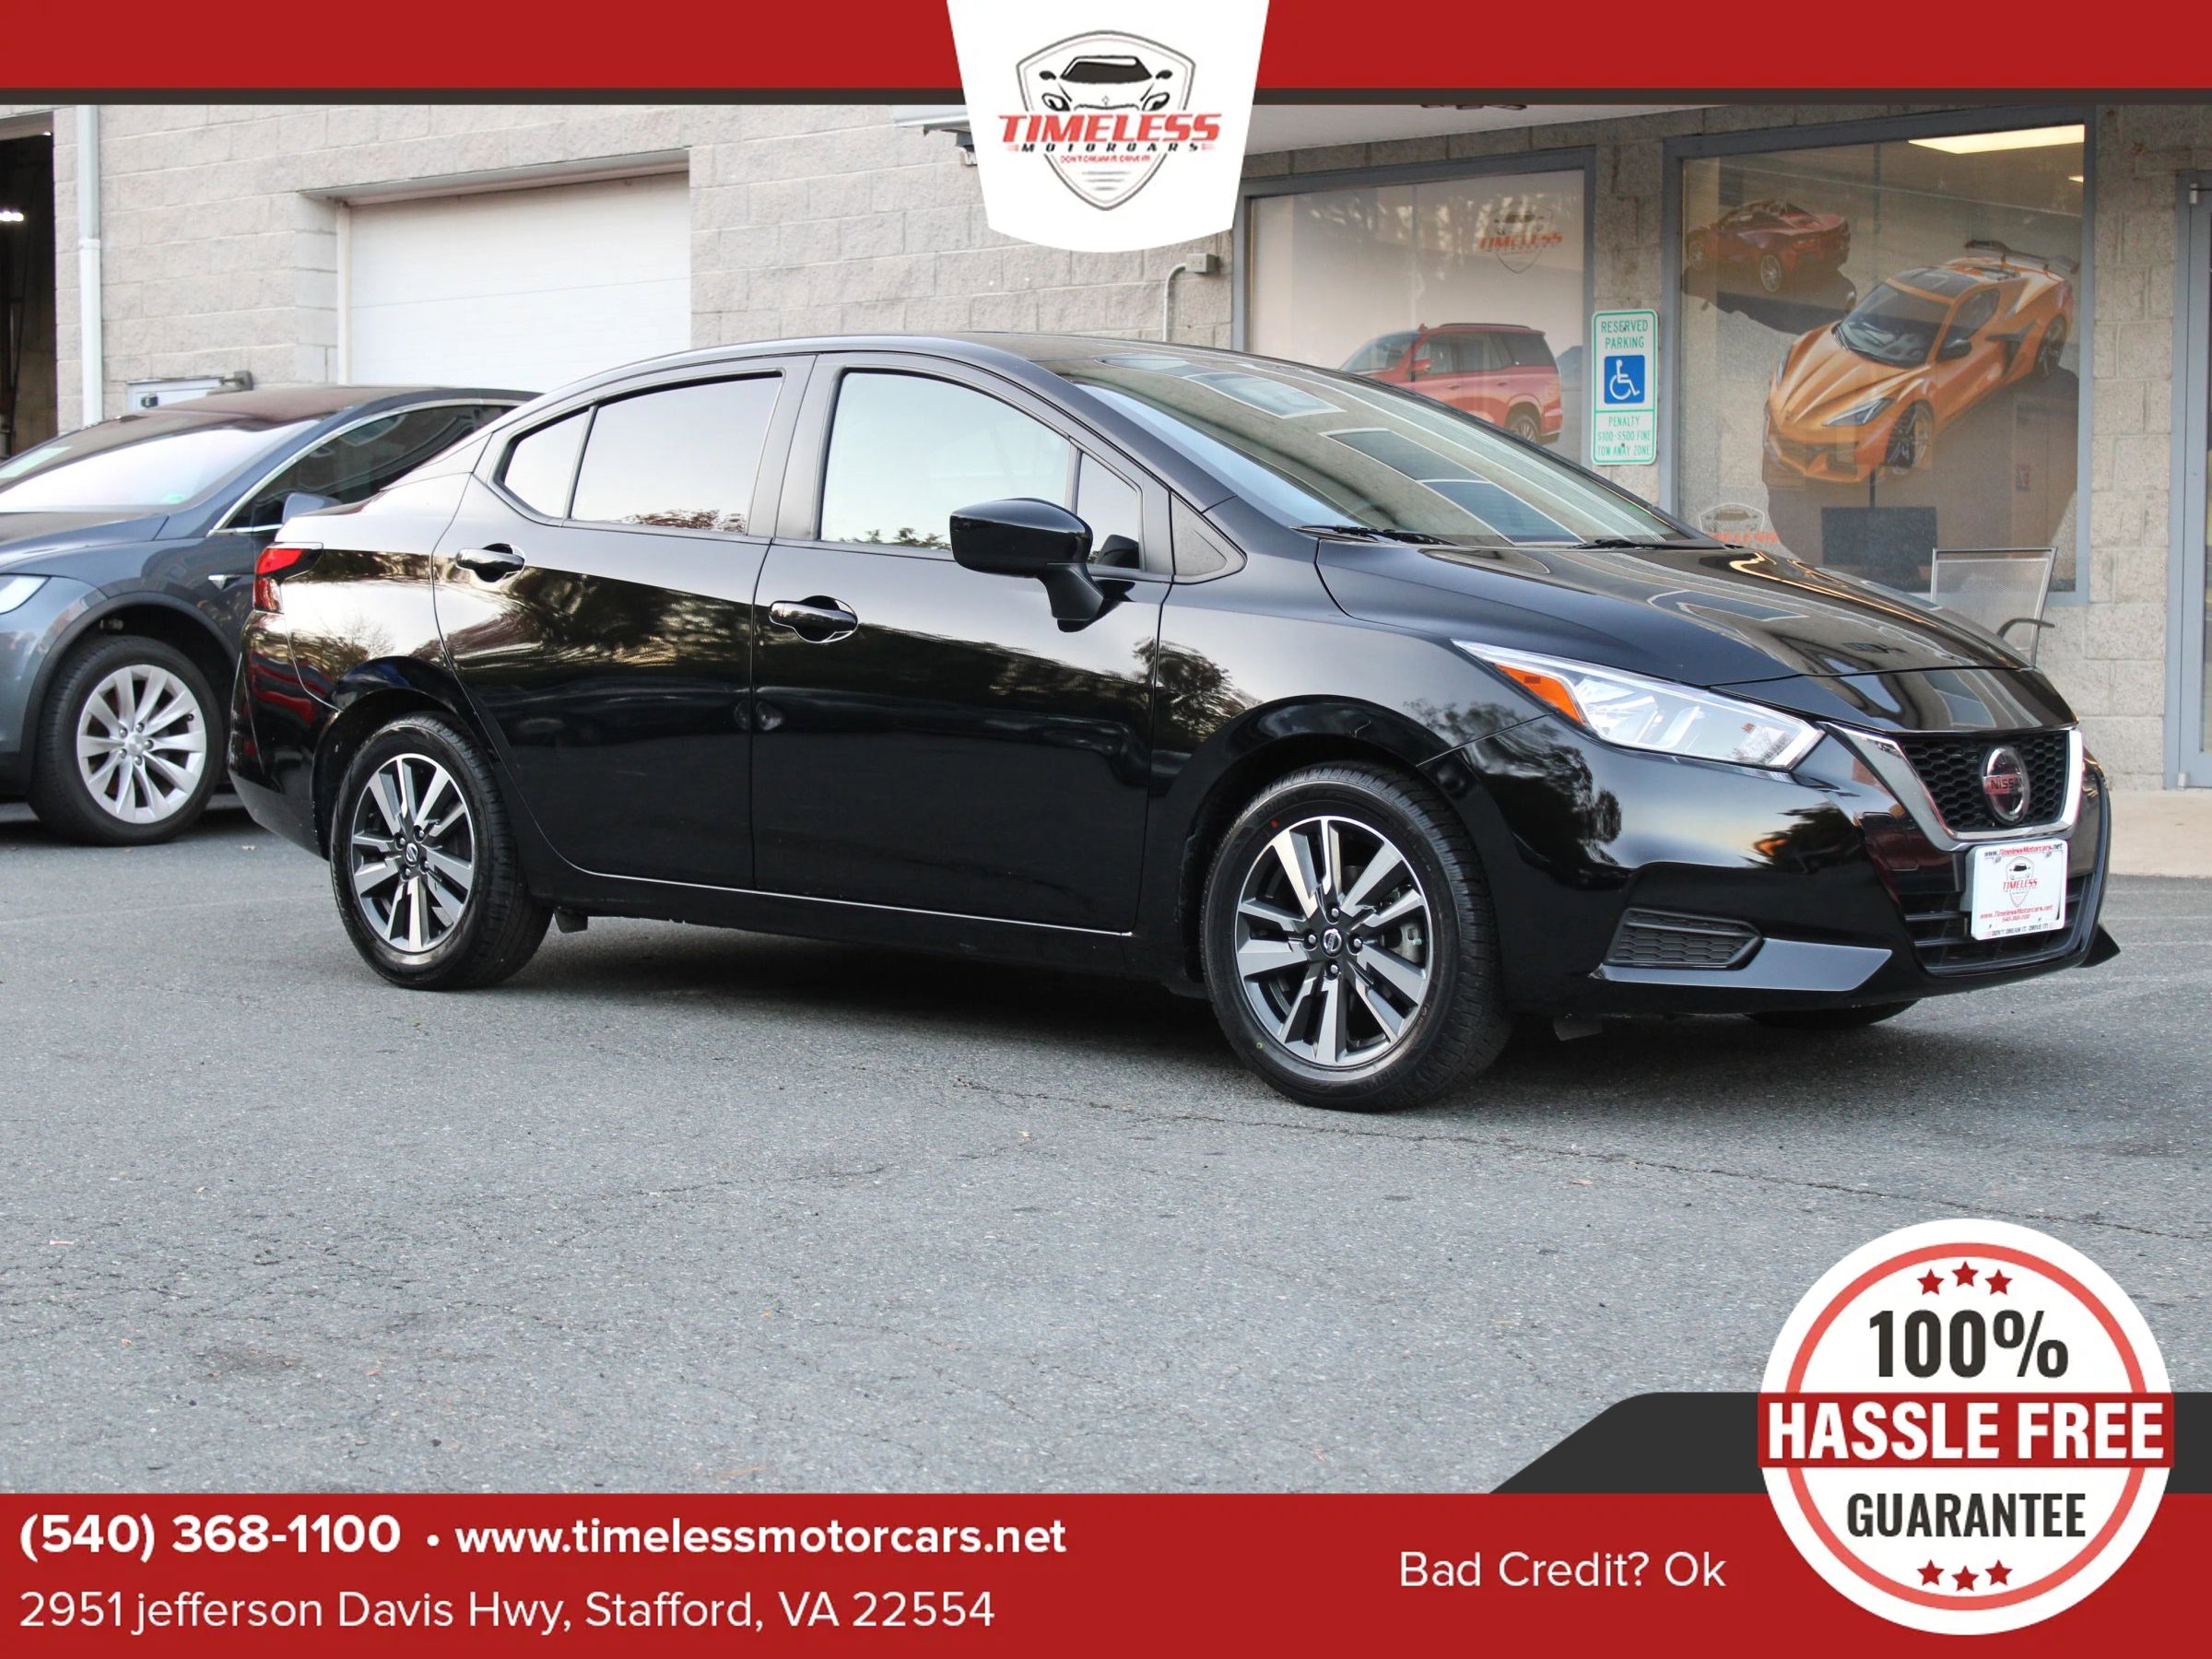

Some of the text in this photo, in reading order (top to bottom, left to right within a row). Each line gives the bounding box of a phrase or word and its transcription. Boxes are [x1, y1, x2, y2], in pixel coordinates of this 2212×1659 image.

[1601, 320, 1648, 333] RESERVED
[1606, 336, 1644, 349] PARKING
[1608, 416, 1640, 427] PENALTY
[1637, 429, 1651, 441] FINE
[2003, 878, 2038, 891] TIMELESS
